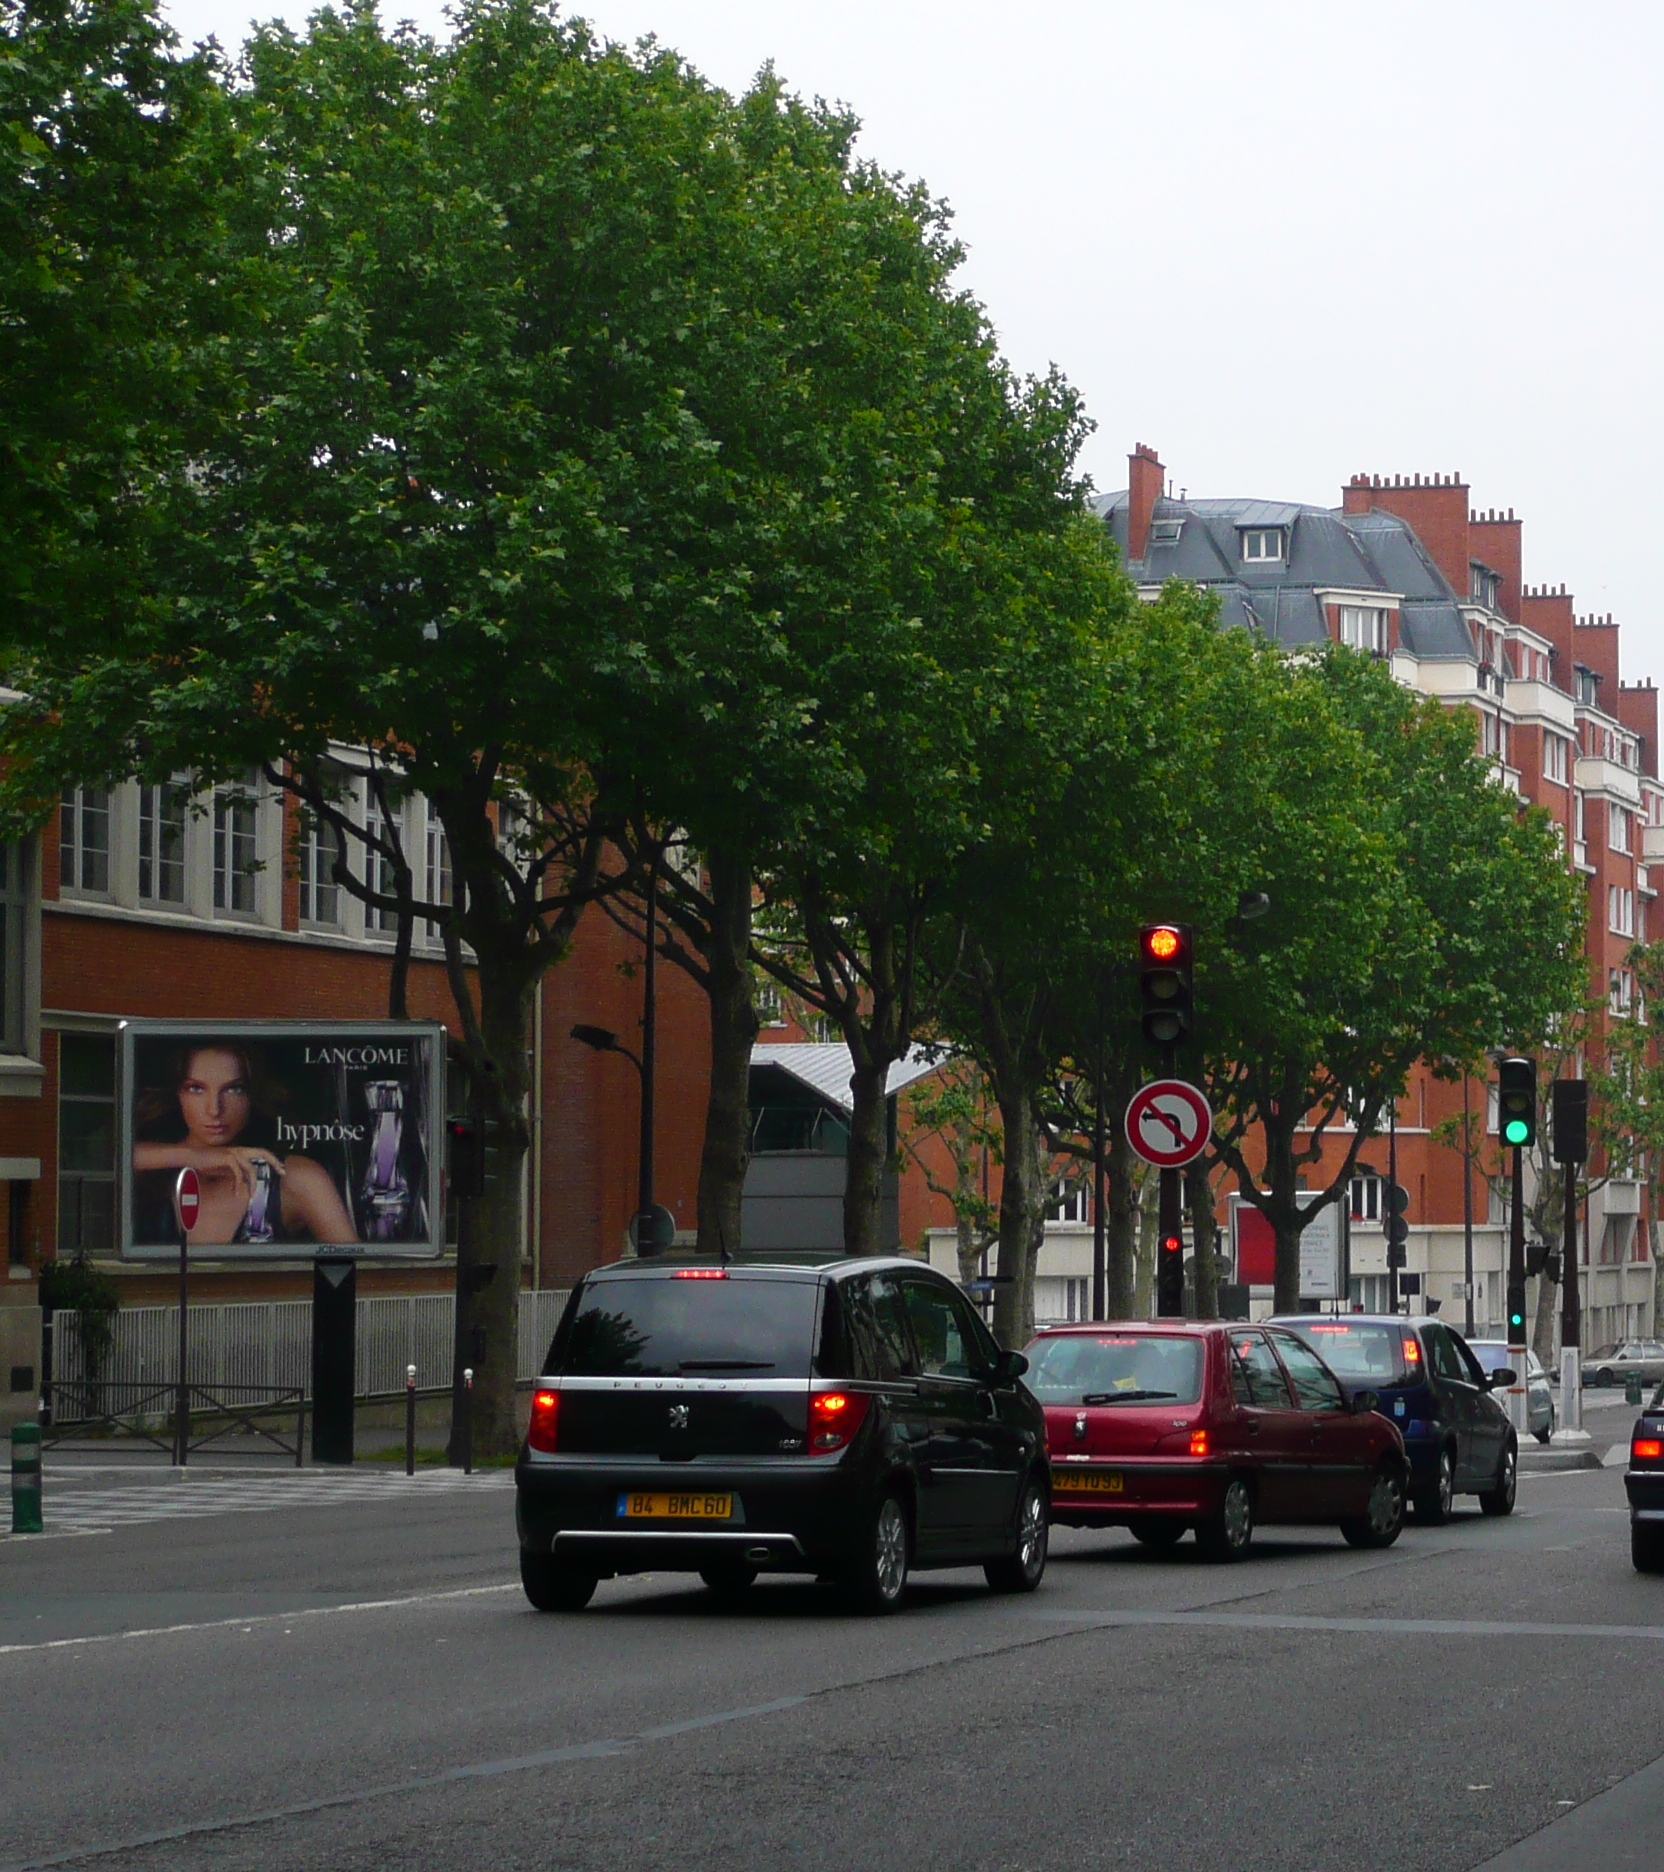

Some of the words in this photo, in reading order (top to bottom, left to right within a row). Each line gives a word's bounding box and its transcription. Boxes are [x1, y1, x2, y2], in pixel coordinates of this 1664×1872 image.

[304, 1044, 409, 1065] LANCÔME
[276, 1115, 365, 1150] hypnôse
[315, 1246, 365, 1254] JCDecaux
[613, 1381, 748, 1390] PEUGEOT
